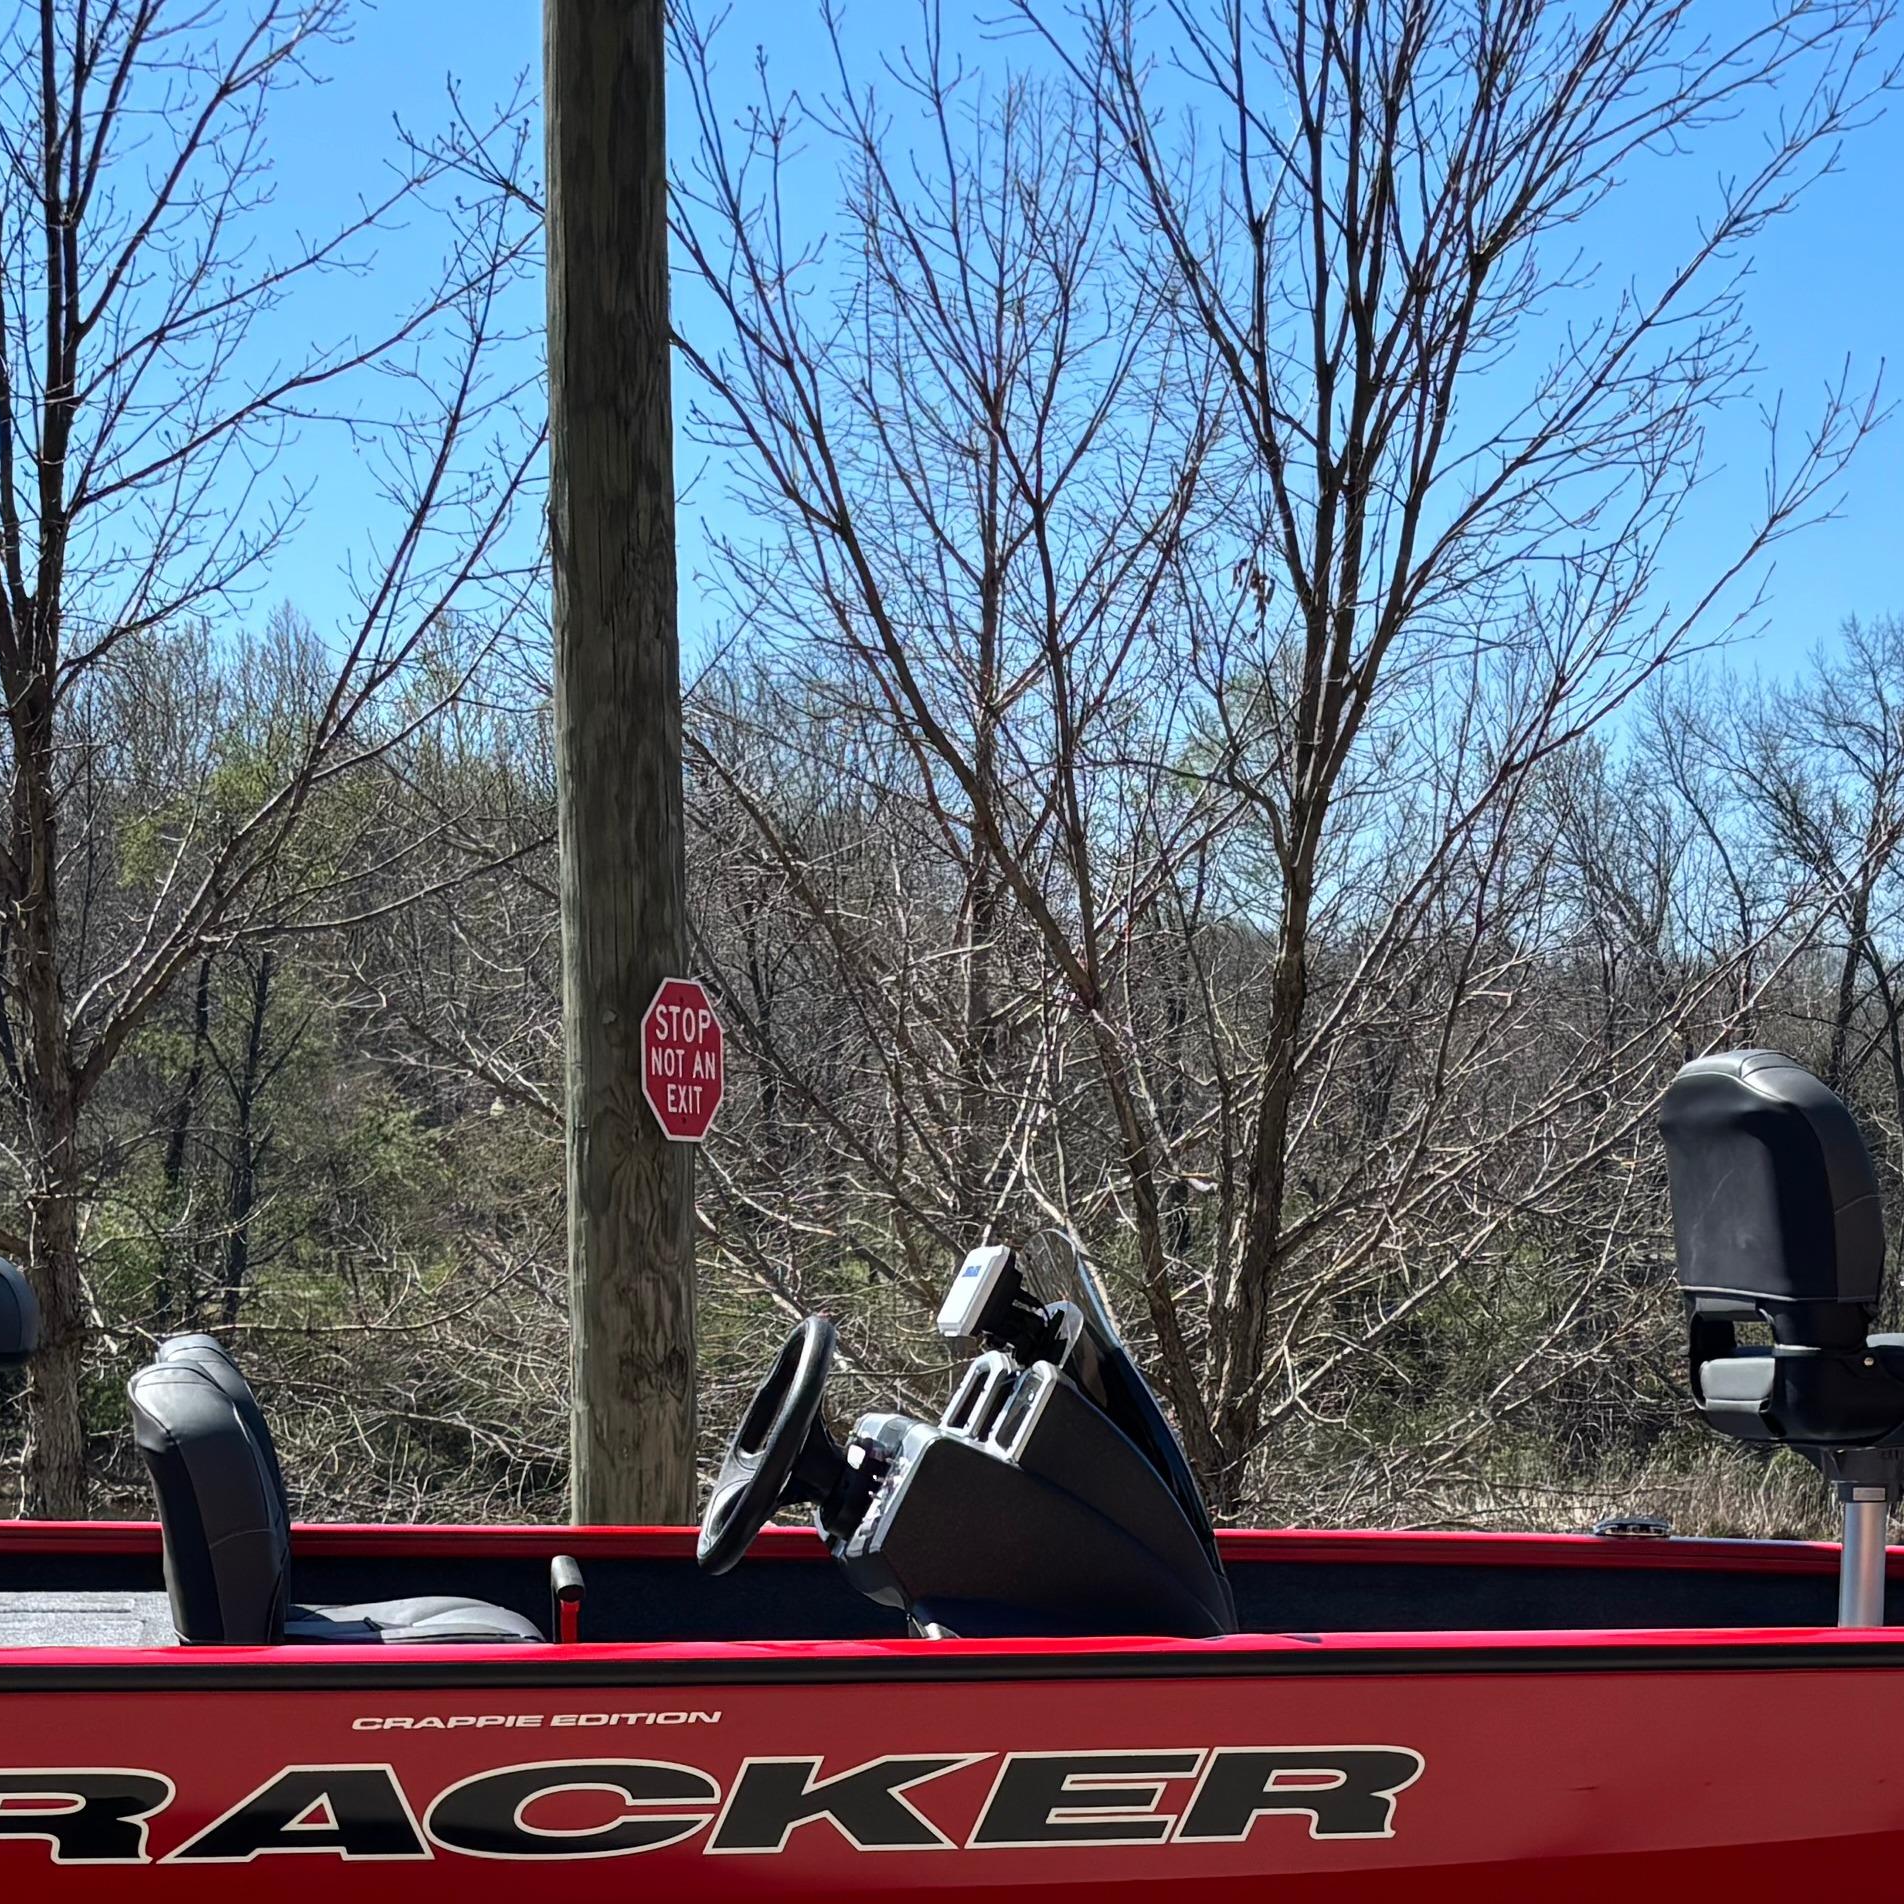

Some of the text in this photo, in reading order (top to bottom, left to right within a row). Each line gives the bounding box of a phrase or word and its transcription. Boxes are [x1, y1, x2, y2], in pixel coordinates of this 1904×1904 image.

[656, 1004, 711, 1044] STOP
[651, 1046, 715, 1080] NOT AN
[667, 1083, 702, 1115] EXIT
[351, 1711, 722, 1730] CRAPPIE EDITION
